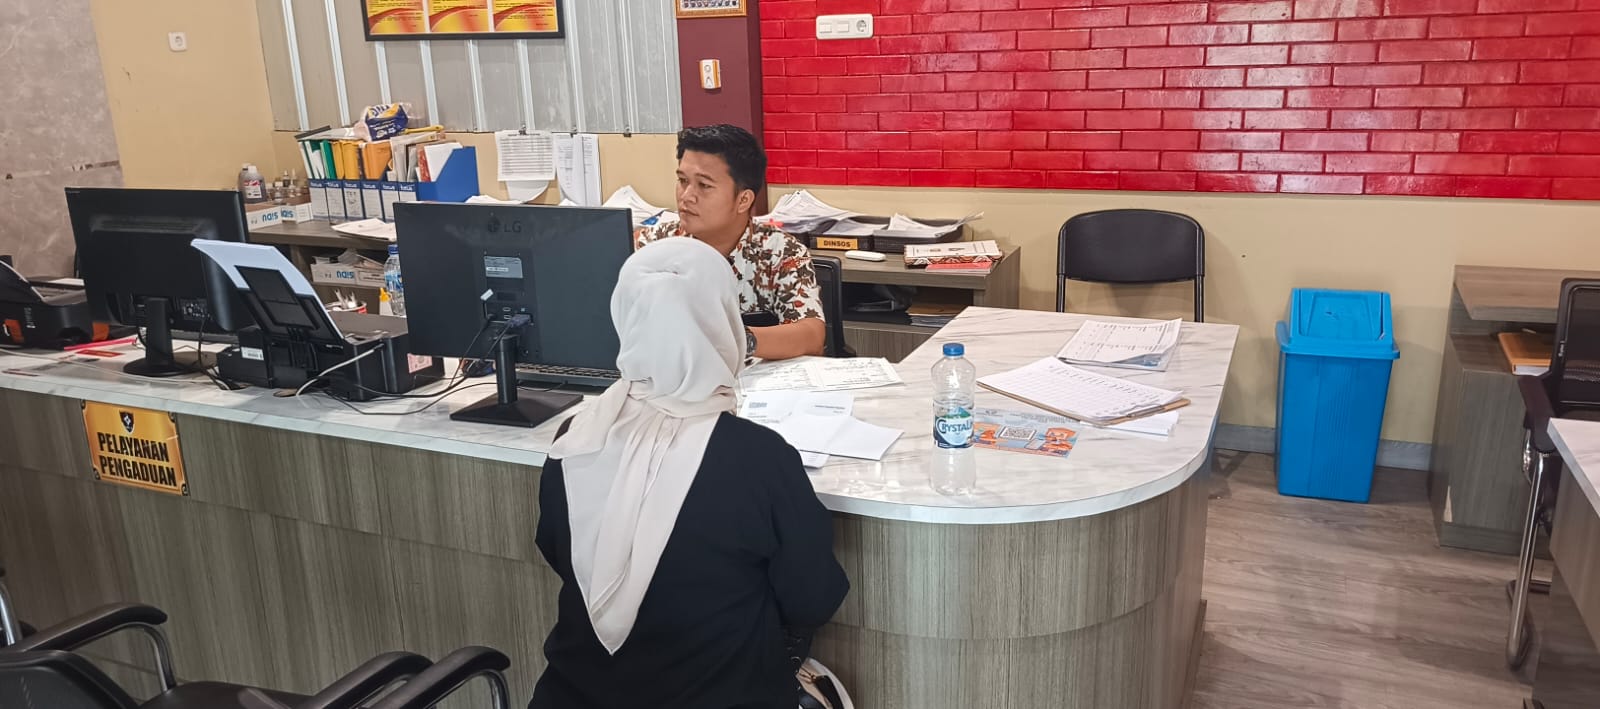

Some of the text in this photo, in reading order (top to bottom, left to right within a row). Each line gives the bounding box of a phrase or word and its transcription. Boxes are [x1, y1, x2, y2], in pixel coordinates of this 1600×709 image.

[504, 221, 521, 233] LG
[98, 432, 169, 462] PELAYANAN
[99, 455, 177, 487] PENGADUAN
